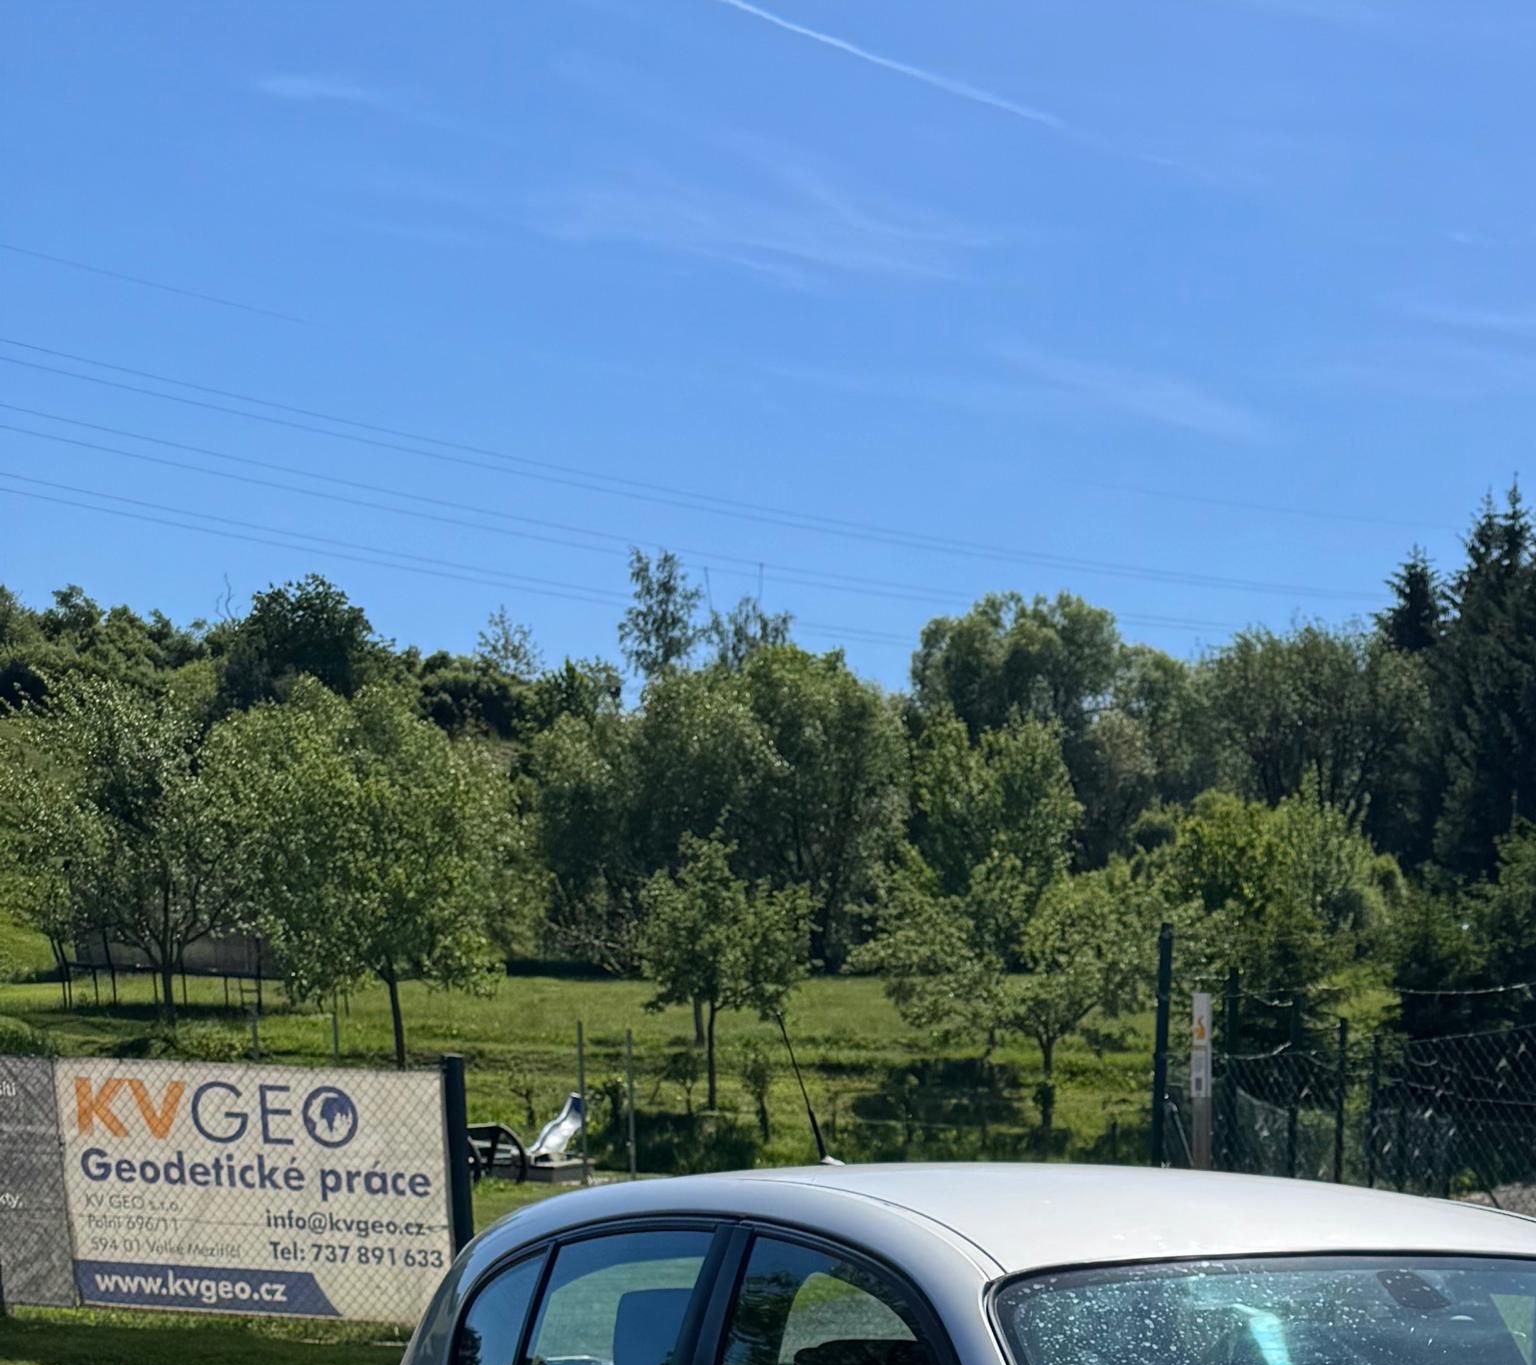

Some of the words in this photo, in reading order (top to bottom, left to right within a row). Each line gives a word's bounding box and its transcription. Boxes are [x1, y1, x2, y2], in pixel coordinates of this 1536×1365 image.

[81, 1147, 305, 1192] Geodetické
[319, 1160, 432, 1200] práce
[109, 1194, 145, 1210] GEO
[266, 1209, 426, 1238] info@kvgeo.cz
[91, 1237, 118, 1251] 594
[269, 1241, 305, 1261] Tel:
[311, 1244, 350, 1263] 737
[357, 1246, 396, 1266] 891
[404, 1249, 444, 1268] 633
[95, 1269, 287, 1303] www.kvgeo.cz
